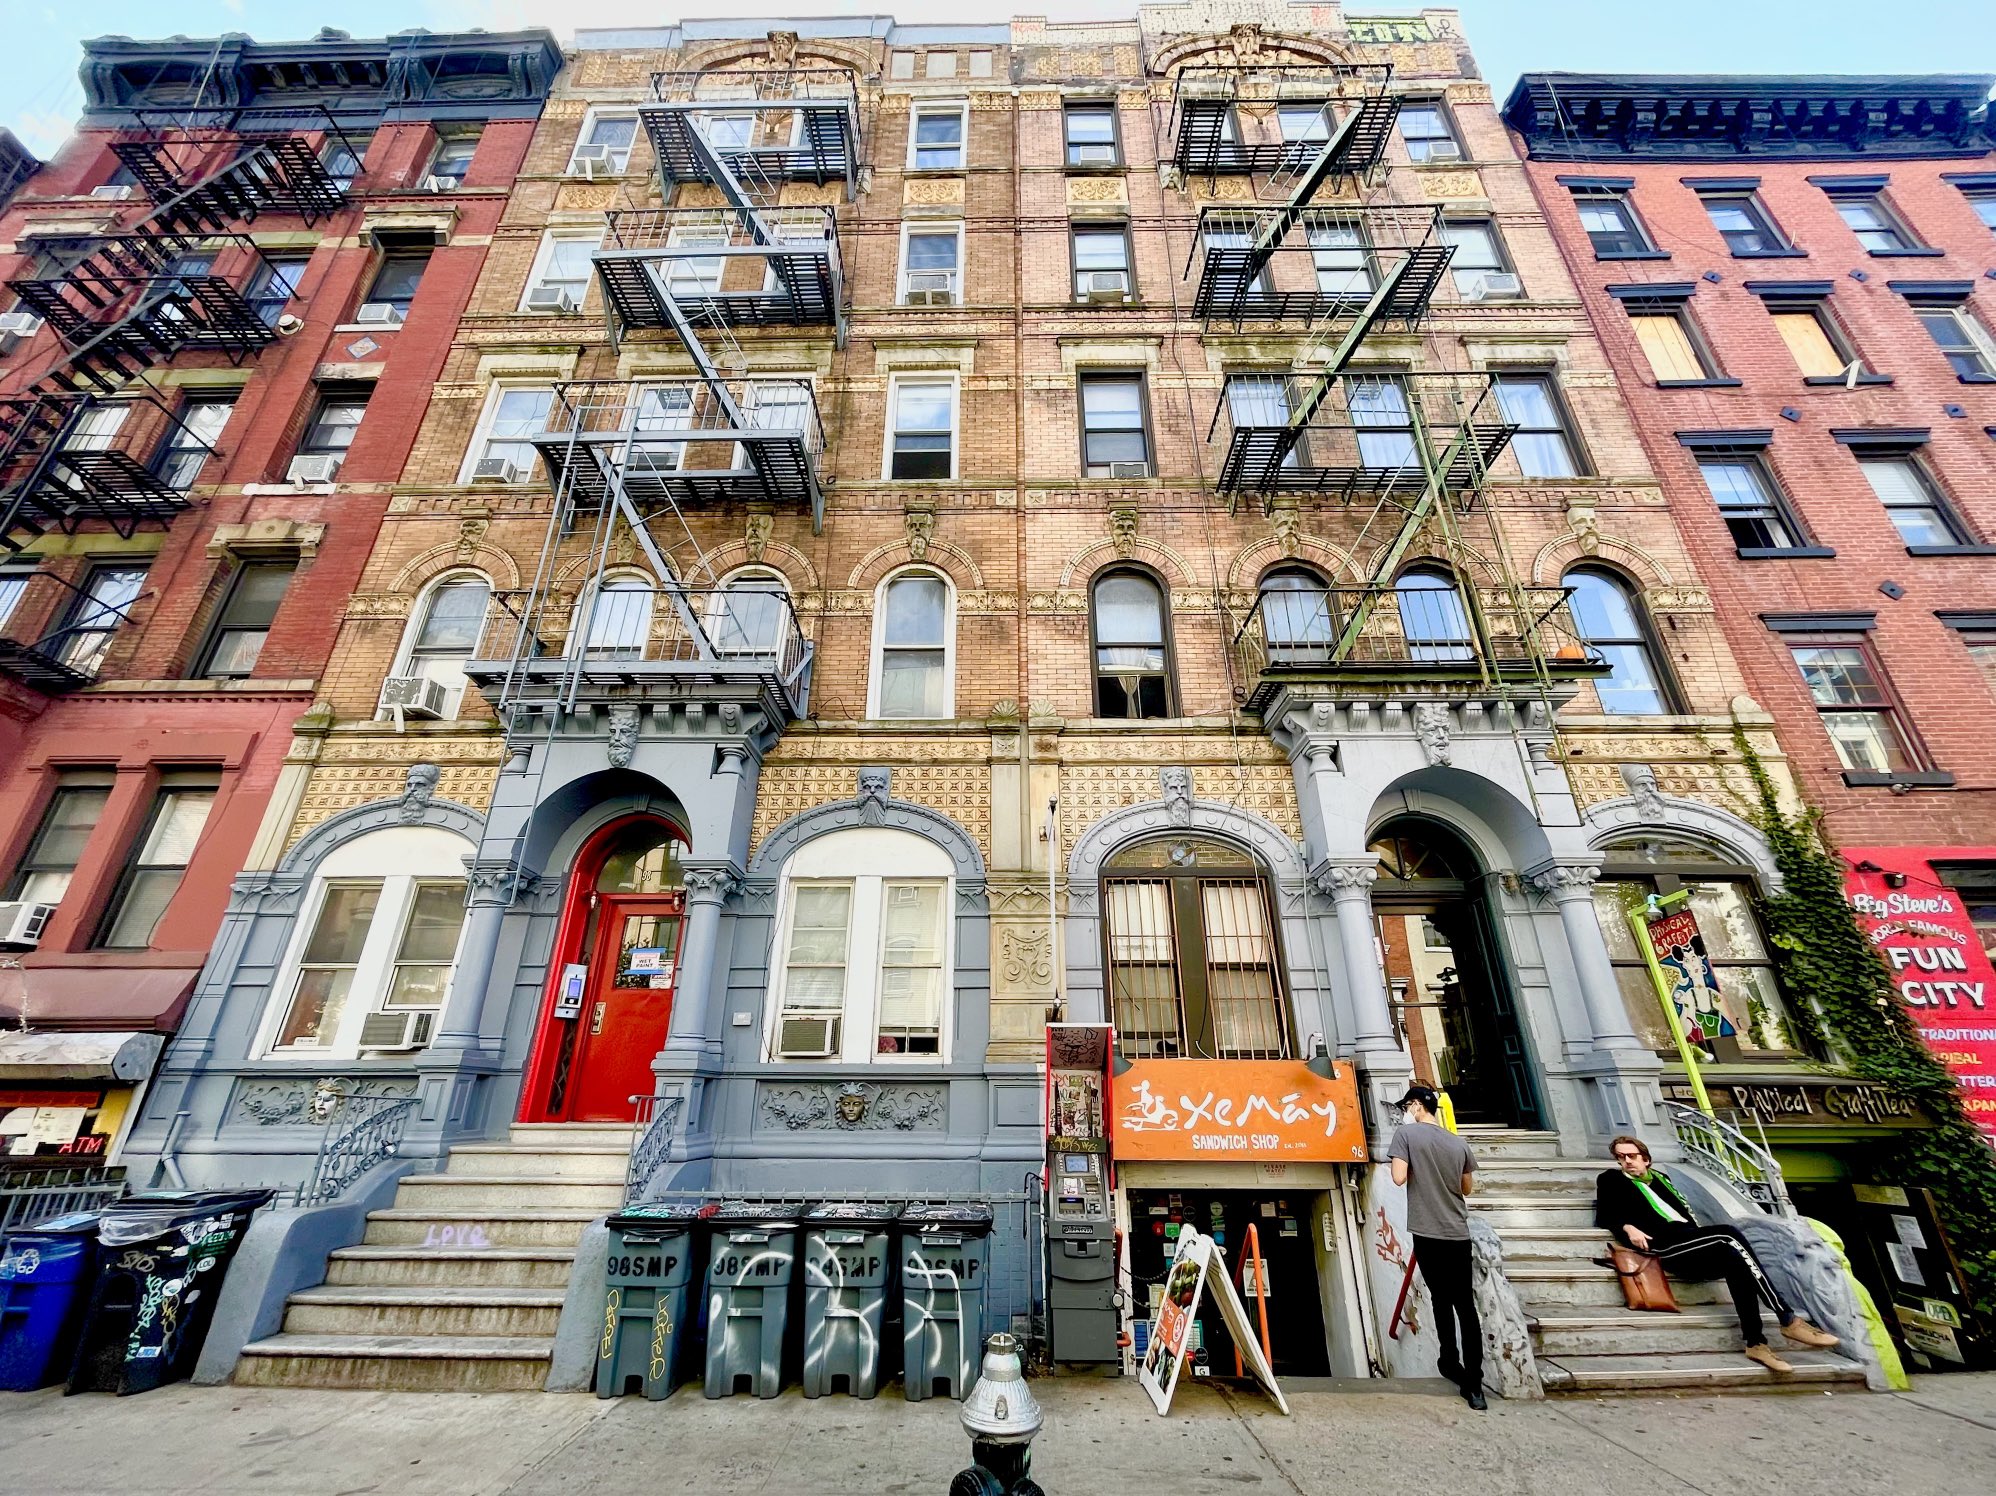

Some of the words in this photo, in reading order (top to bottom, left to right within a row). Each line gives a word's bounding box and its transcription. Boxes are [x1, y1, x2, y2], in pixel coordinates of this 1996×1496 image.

[1853, 893, 1888, 919] Big
[1887, 893, 1953, 914] Steve's
[1907, 920, 1967, 945] FAMOUS
[1887, 947, 1967, 971] FUN
[1901, 981, 1985, 1007] CITY
[1919, 1028, 1996, 1041] TRADITION
[1937, 1052, 1982, 1065] RIBAL
[59, 1137, 103, 1153] ATM
[1192, 1134, 1248, 1150] SANDWICH
[1250, 1133, 1280, 1150] SHOP
[1351, 1146, 1364, 1158] 96
[607, 1255, 678, 1278] 98SMP
